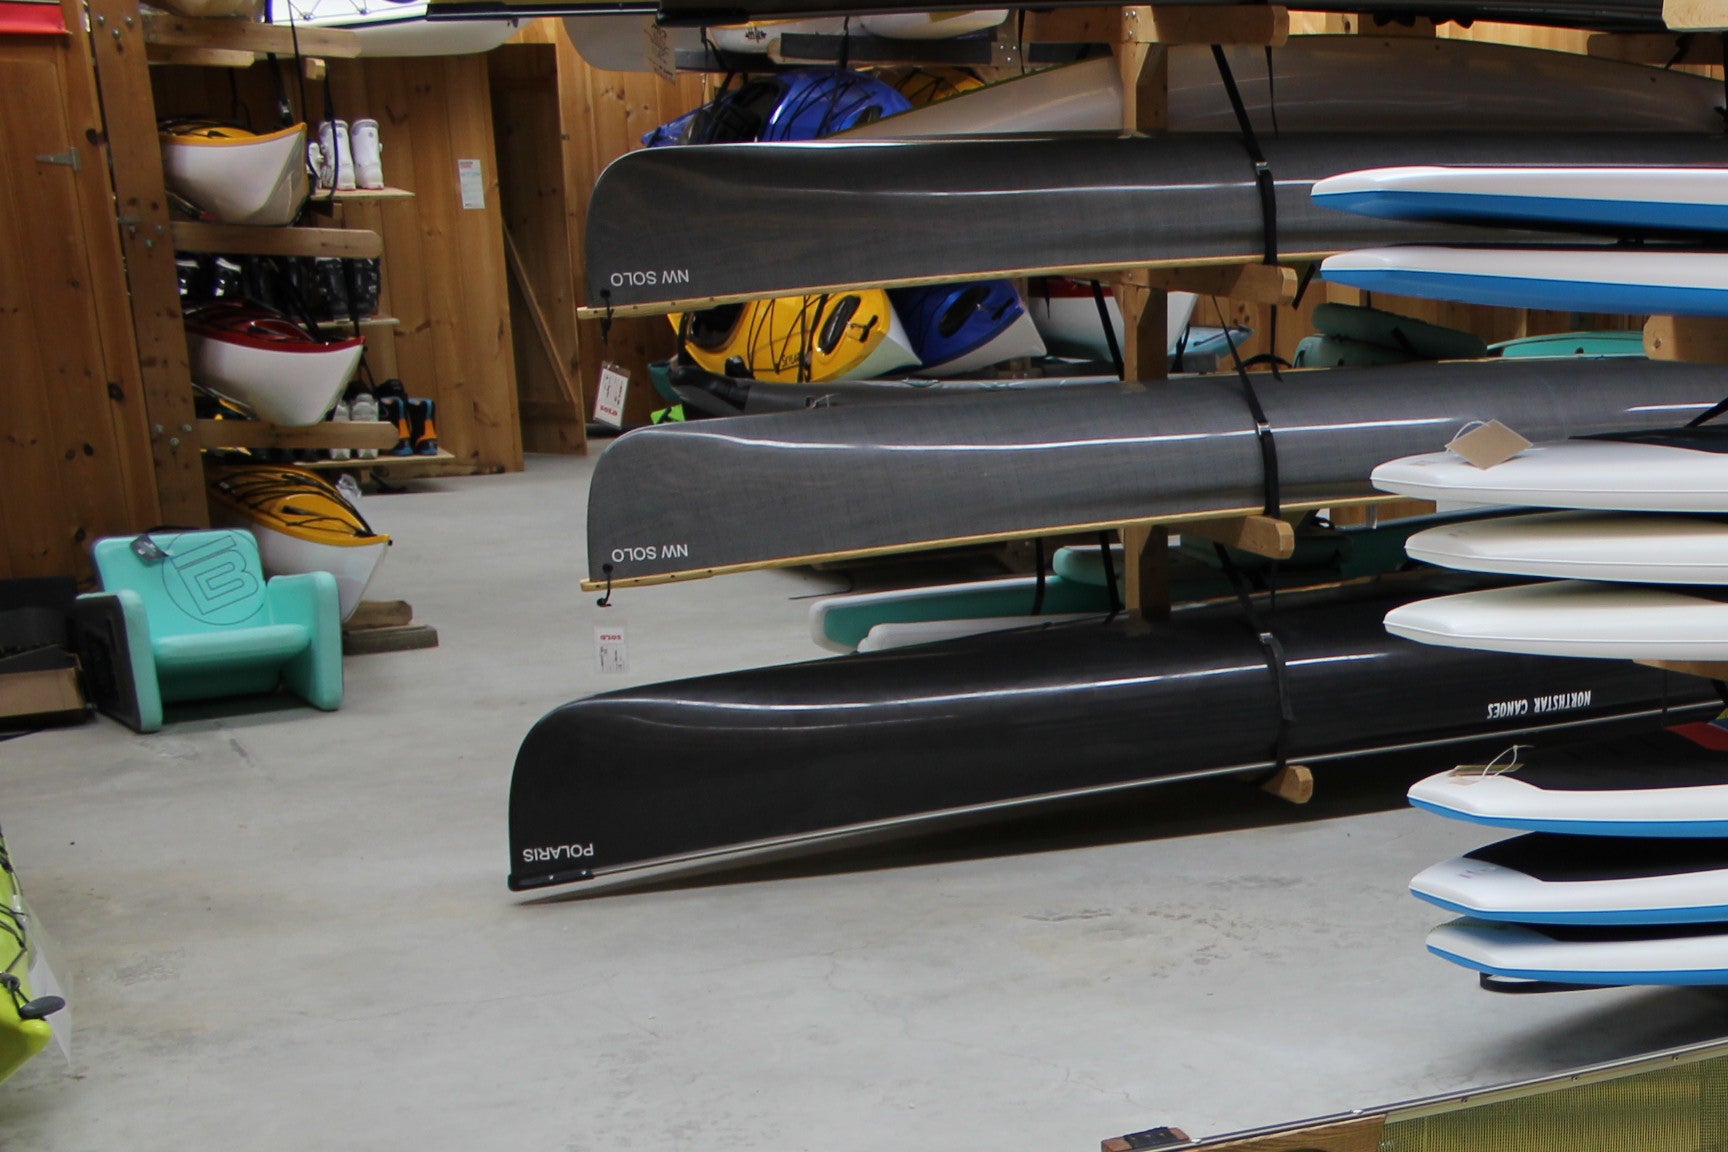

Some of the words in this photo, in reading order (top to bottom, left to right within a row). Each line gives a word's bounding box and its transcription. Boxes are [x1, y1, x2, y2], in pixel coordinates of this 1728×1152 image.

[610, 270, 658, 287] SOLO
[661, 269, 690, 284] NW
[611, 546, 658, 563] SOLO
[661, 543, 689, 559] NW
[1486, 699, 1529, 719] CANOES
[1534, 690, 1592, 713] NORTHSTAR
[522, 843, 595, 862] POLARIS
